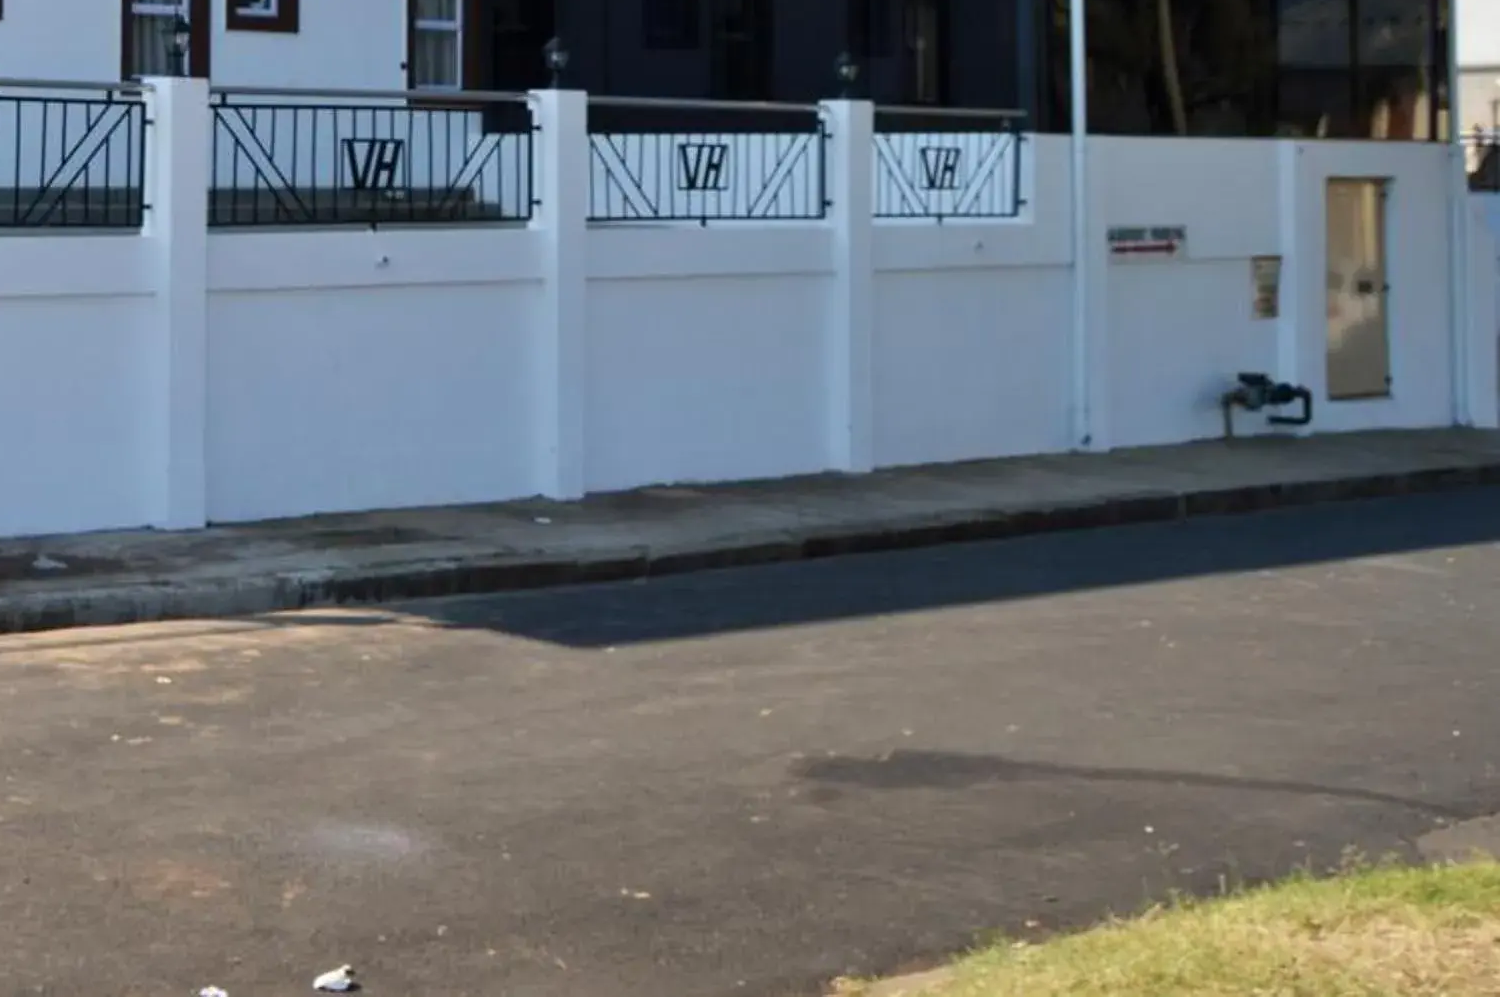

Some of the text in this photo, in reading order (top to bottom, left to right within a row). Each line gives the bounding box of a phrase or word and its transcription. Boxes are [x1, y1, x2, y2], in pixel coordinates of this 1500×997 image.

[346, 139, 402, 189] VH
[680, 144, 727, 190] VH
[920, 147, 961, 190] VH
